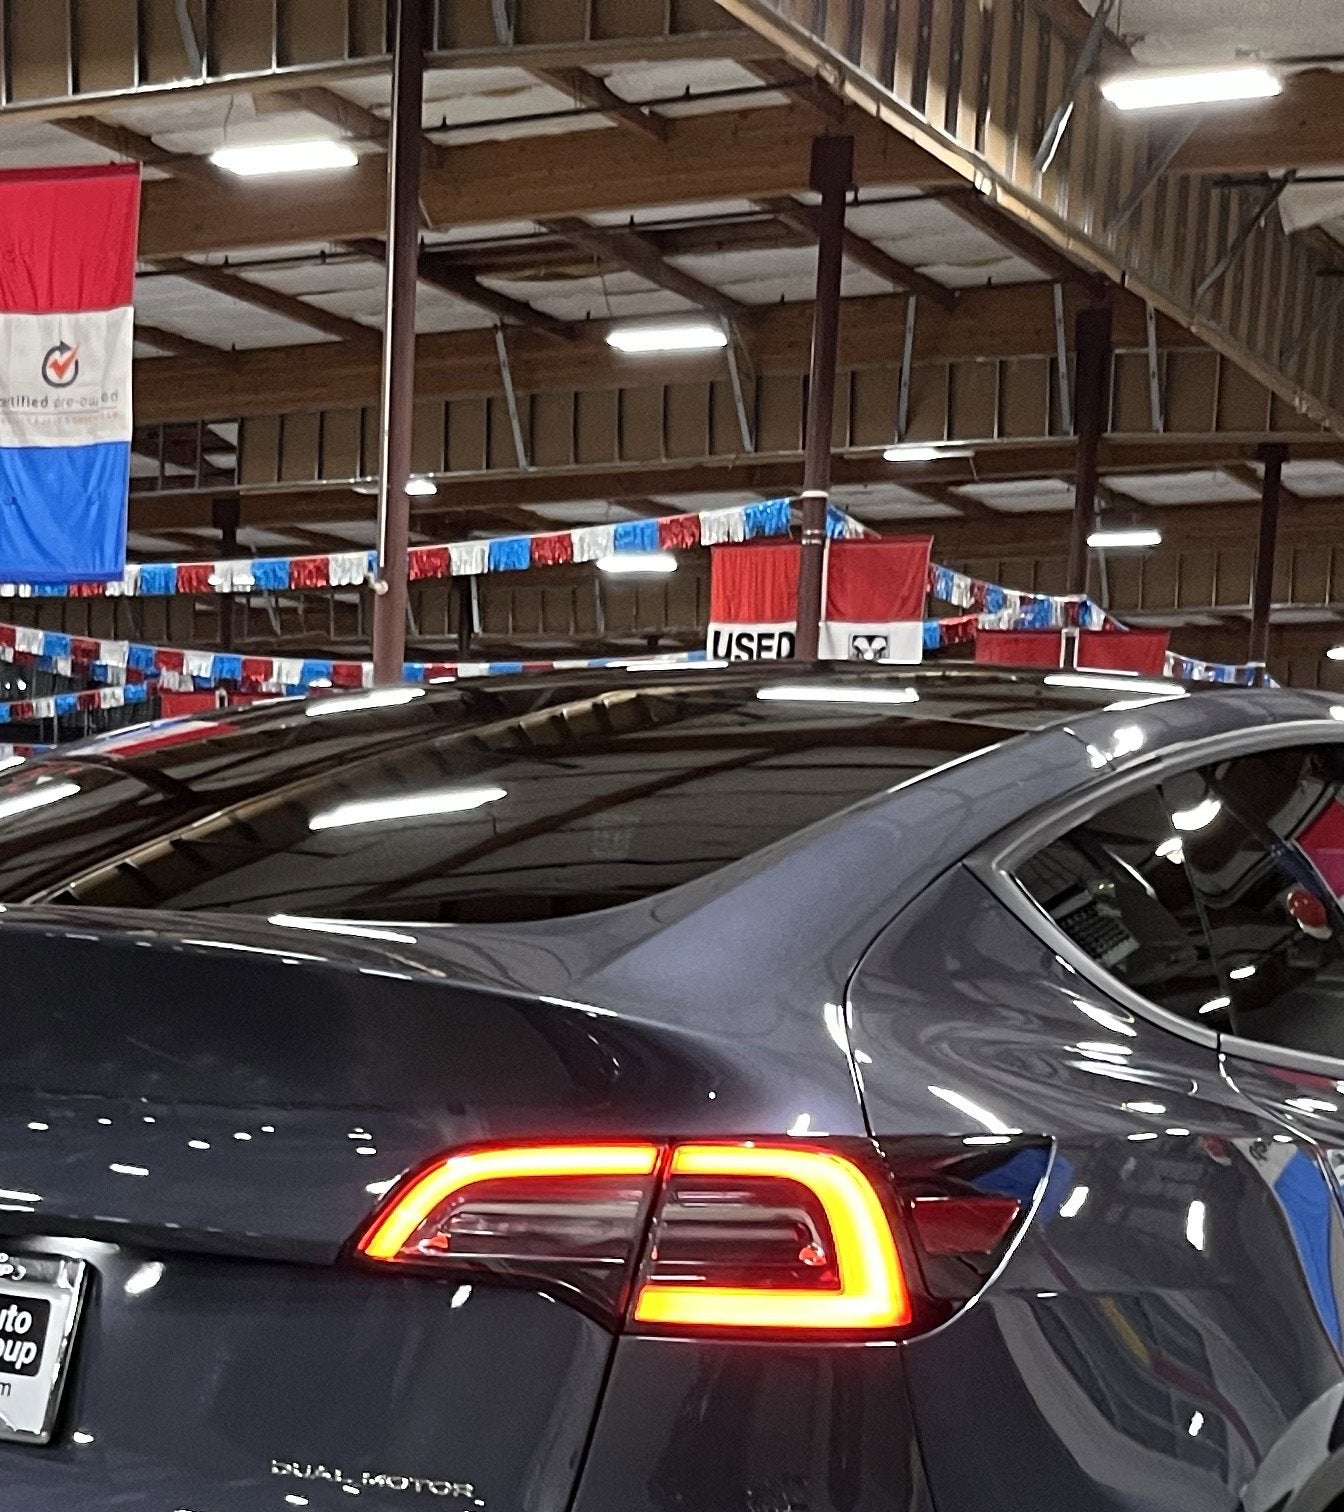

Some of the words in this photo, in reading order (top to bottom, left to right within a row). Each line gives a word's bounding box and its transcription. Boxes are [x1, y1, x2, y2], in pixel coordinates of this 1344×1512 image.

[54, 390, 119, 409] pre-owed
[713, 630, 795, 660] USED
[271, 1459, 354, 1483] DUAL
[362, 1472, 474, 1498] MOTOR
